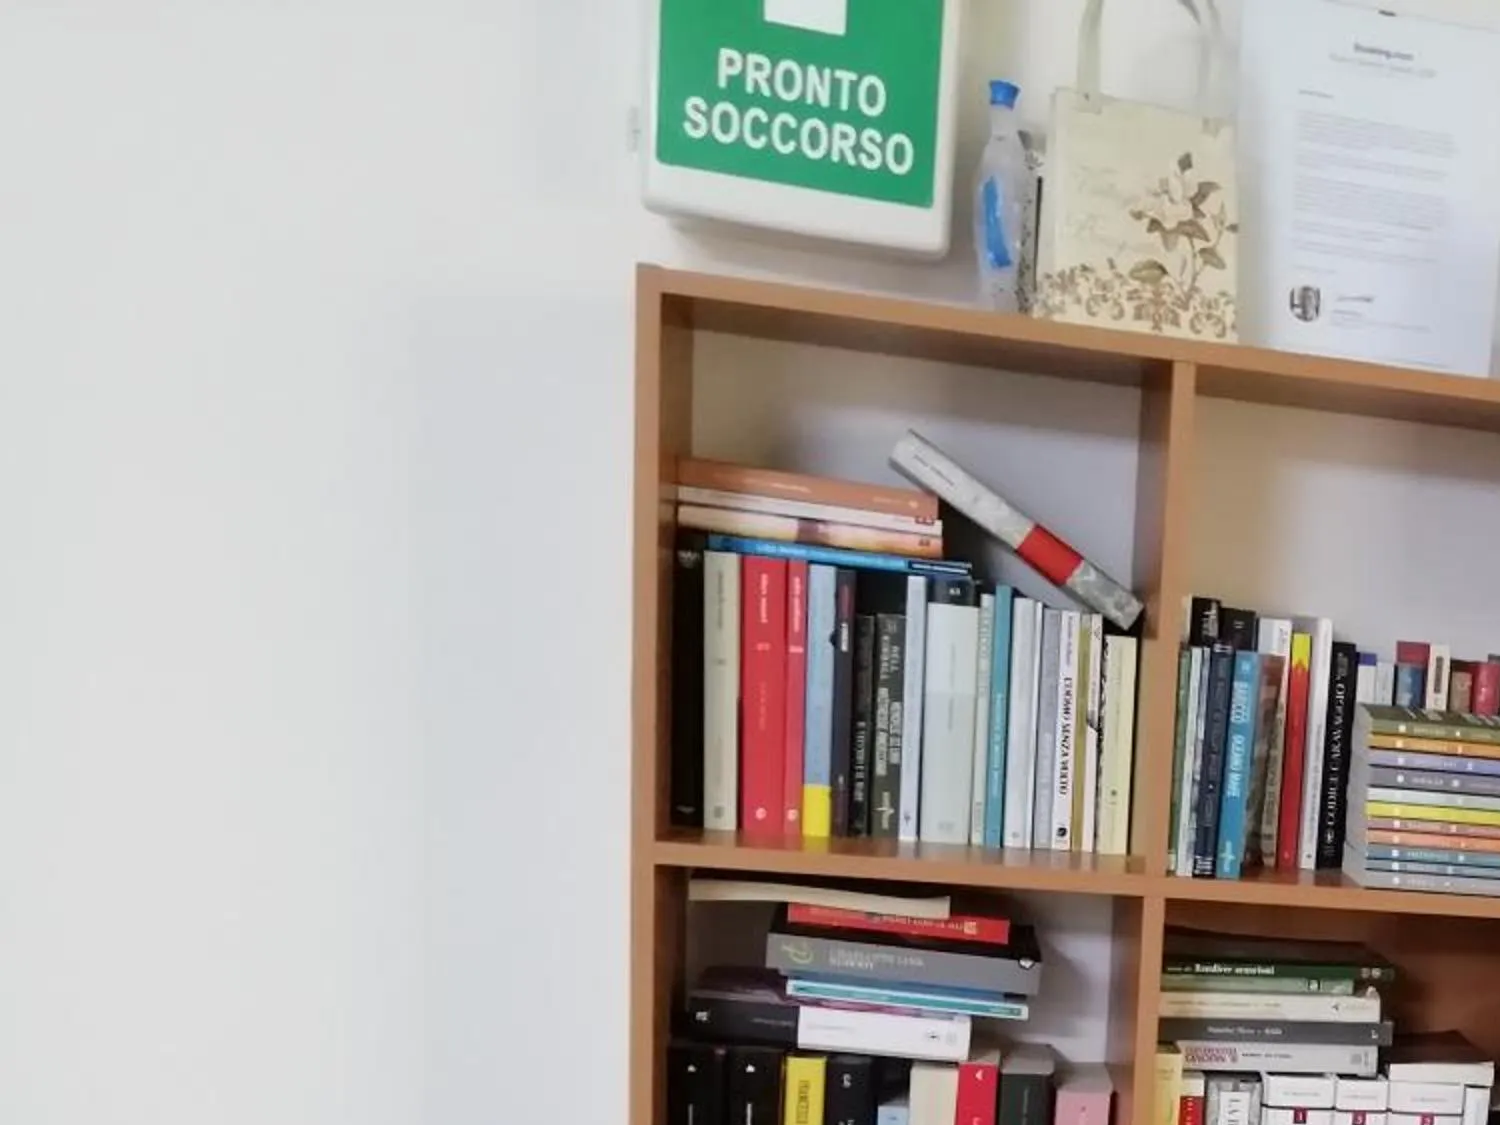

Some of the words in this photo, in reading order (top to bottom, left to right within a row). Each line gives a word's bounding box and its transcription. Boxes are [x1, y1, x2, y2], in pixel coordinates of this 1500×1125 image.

[717, 48, 886, 116] PRONTO
[683, 96, 914, 176] SOCCORSO
[1059, 722, 1072, 756] SENZA
[1329, 683, 1346, 772] CARAVAGGIO
[1227, 1098, 1242, 1116] LA
